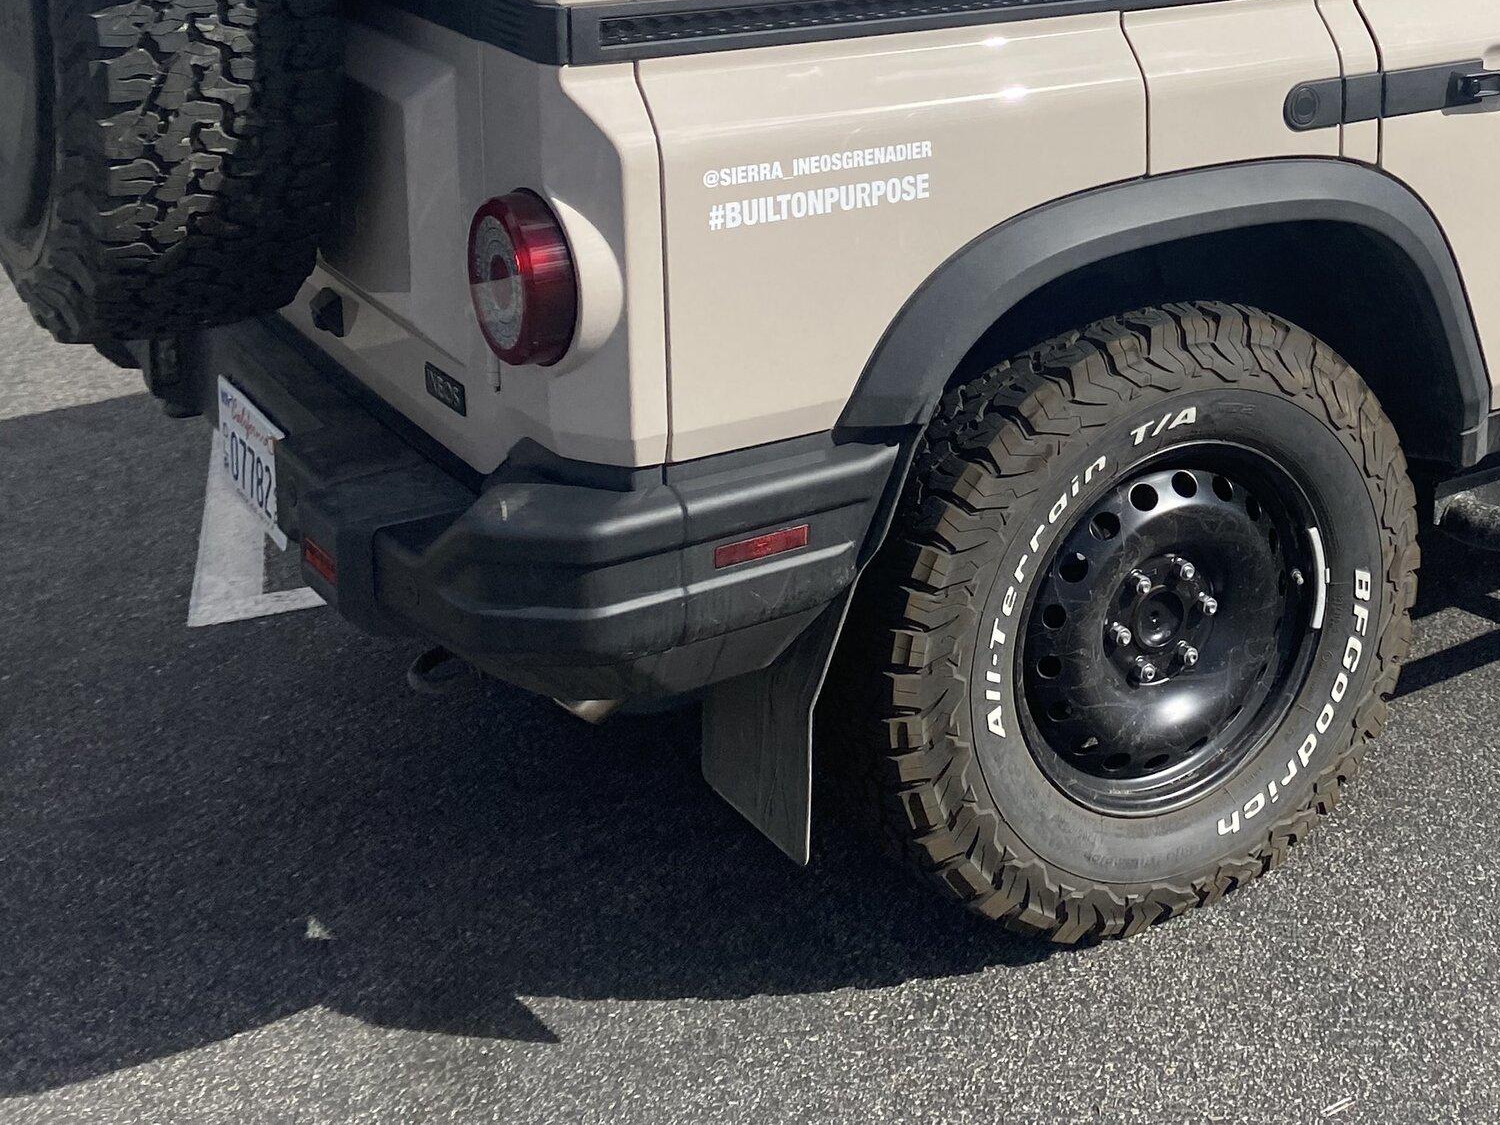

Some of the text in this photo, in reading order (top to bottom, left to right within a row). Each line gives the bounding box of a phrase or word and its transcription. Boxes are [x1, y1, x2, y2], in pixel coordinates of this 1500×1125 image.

[702, 140, 932, 188] @SIERRA_INEOSGRENADIER
[708, 173, 930, 231] #BUILTONPURPOSE
[985, 406, 1197, 738] All-Terrain T/A
[1217, 568, 1371, 836] BFGoodrich
